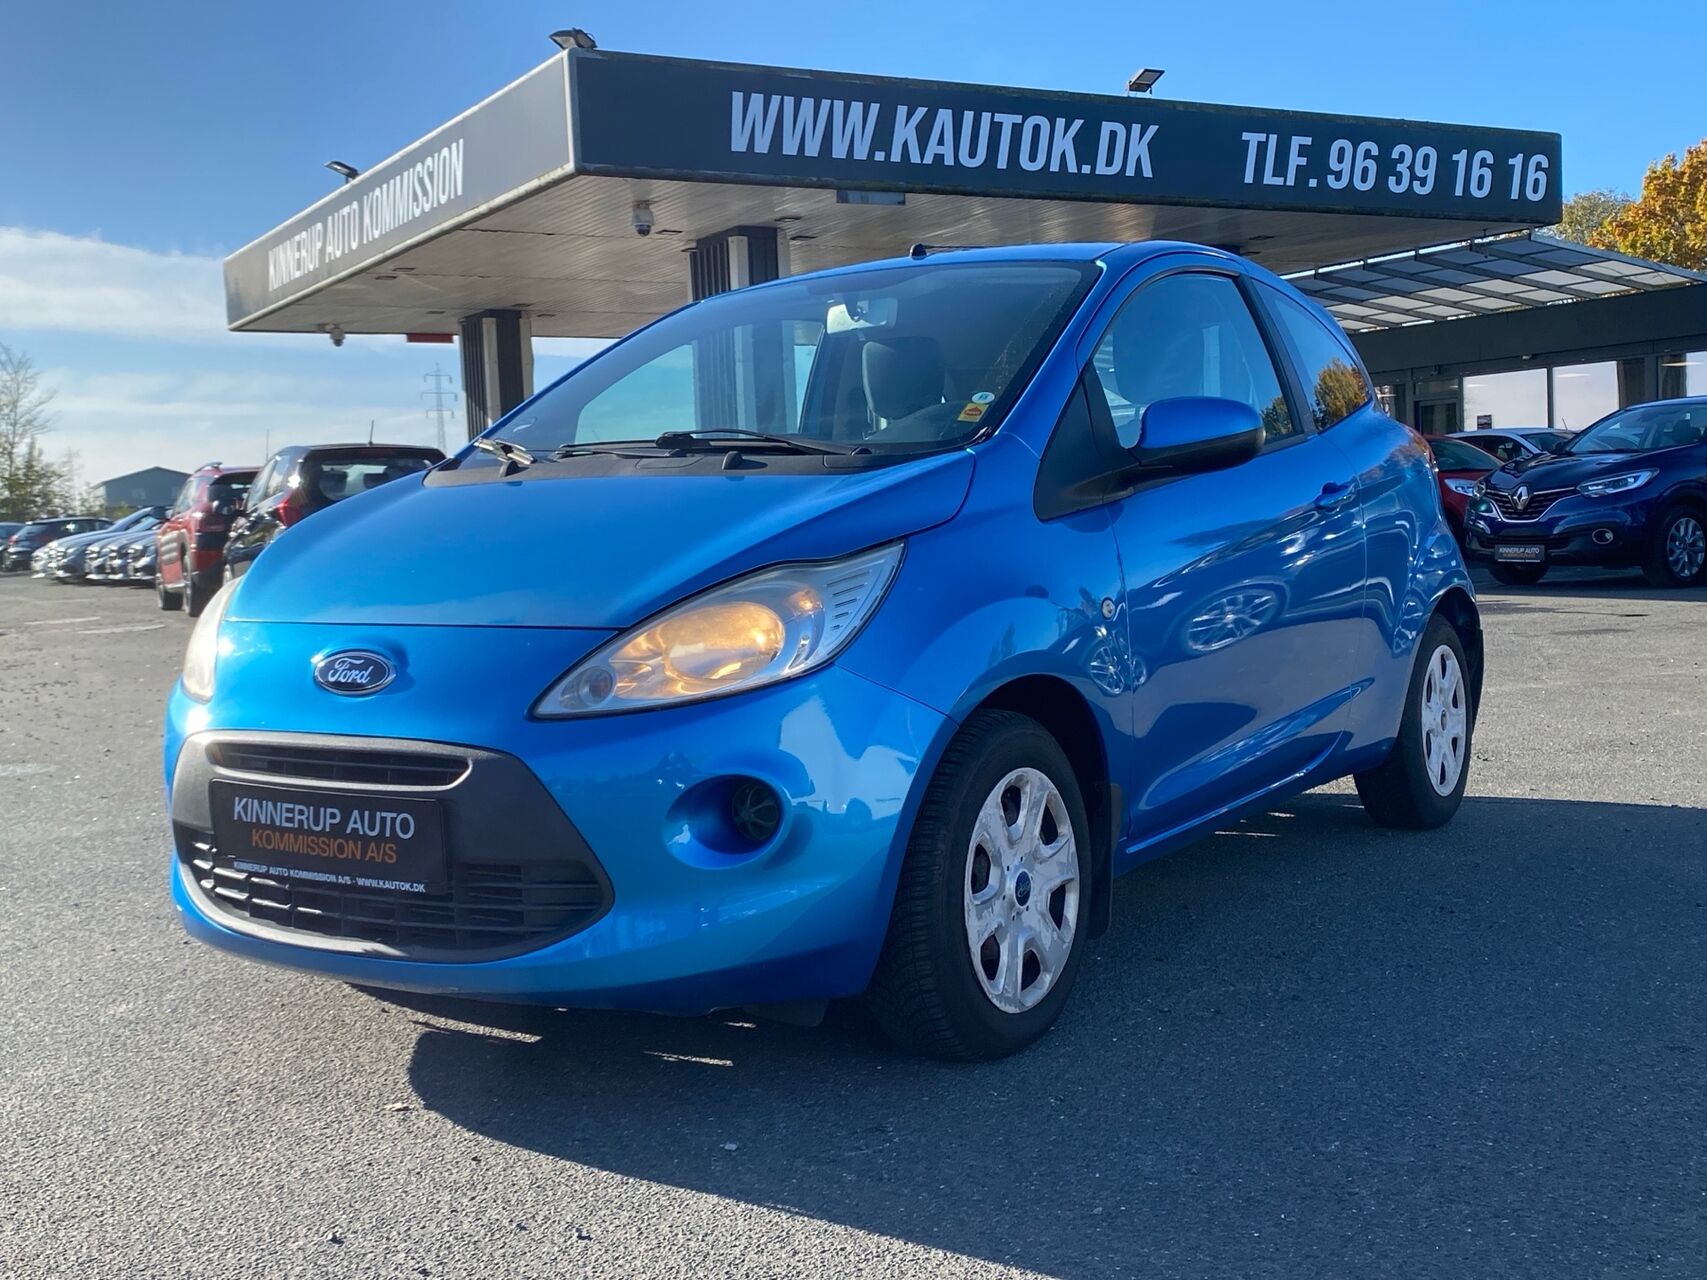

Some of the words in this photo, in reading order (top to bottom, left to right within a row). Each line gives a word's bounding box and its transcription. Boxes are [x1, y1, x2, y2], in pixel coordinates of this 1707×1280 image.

[730, 91, 1159, 178] WWW.KAUTOK.DK
[1241, 131, 1318, 188] TLF.
[1327, 139, 1379, 191] 96
[1388, 144, 1438, 195] 39
[1452, 149, 1494, 198] 16
[1508, 153, 1549, 201] 16
[268, 222, 323, 292] KINNERUP
[325, 201, 359, 263] AUTO
[363, 138, 464, 244] KOMMISSION
[328, 658, 374, 683] Ford
[233, 797, 341, 832] KINNERUP
[346, 809, 415, 839] AUTO
[252, 829, 361, 860] KOMMISSION
[365, 841, 397, 863] A/S
[233, 860, 268, 873] KINNERUP
[269, 866, 288, 877] AUTO
[290, 869, 336, 883] KOMMISSION
[338, 875, 352, 885] A/S
[356, 877, 426, 893] WWW.KAUTOK.DK
